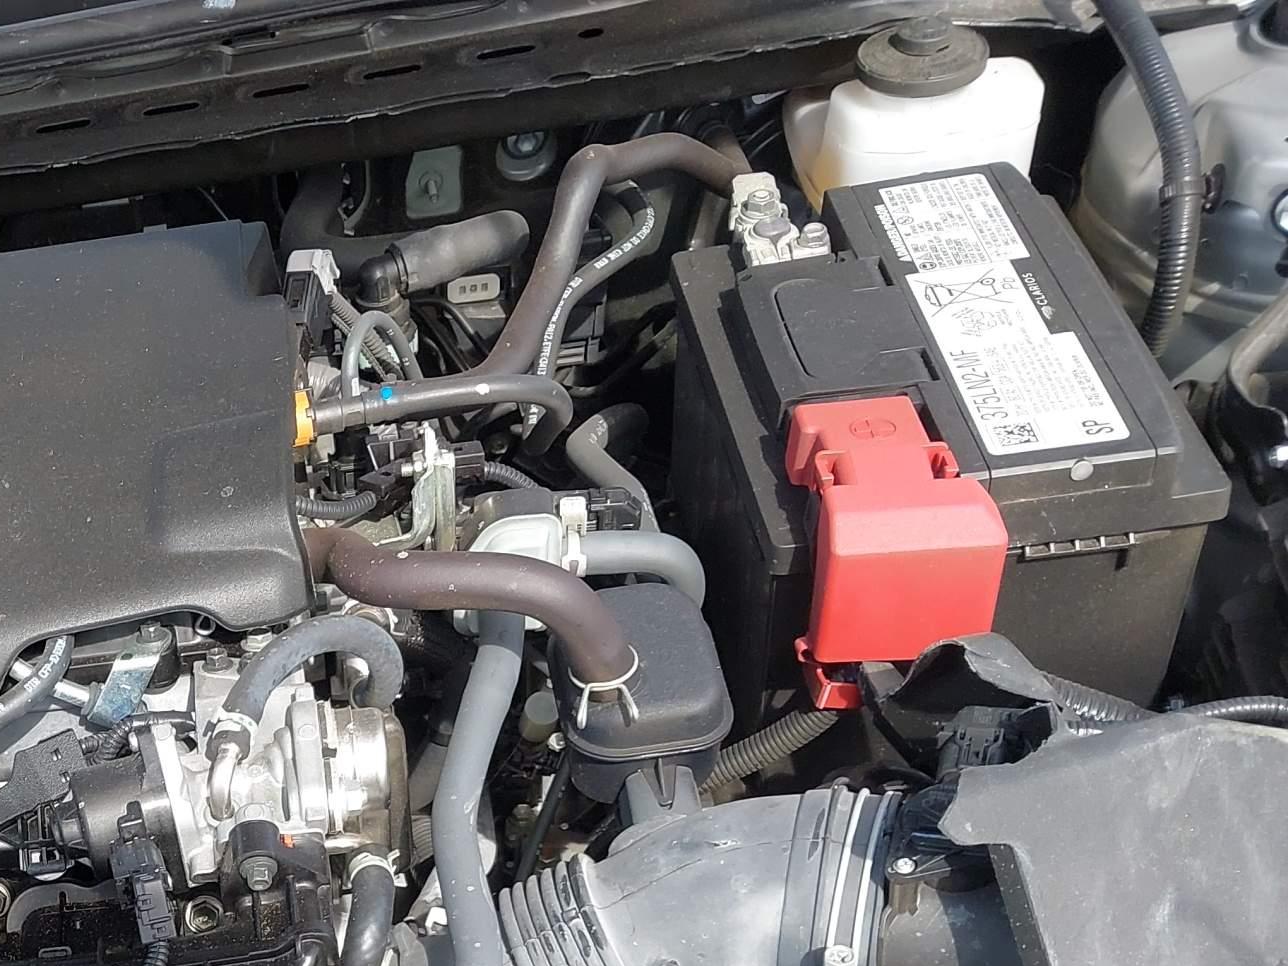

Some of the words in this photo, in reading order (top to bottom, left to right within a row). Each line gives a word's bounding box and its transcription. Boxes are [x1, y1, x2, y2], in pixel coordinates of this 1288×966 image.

[999, 277, 1018, 290] Pb
[1021, 272, 1048, 305] CLARIOS
[950, 350, 1008, 421] 375LN2-MF
[1080, 417, 1115, 436] SP
